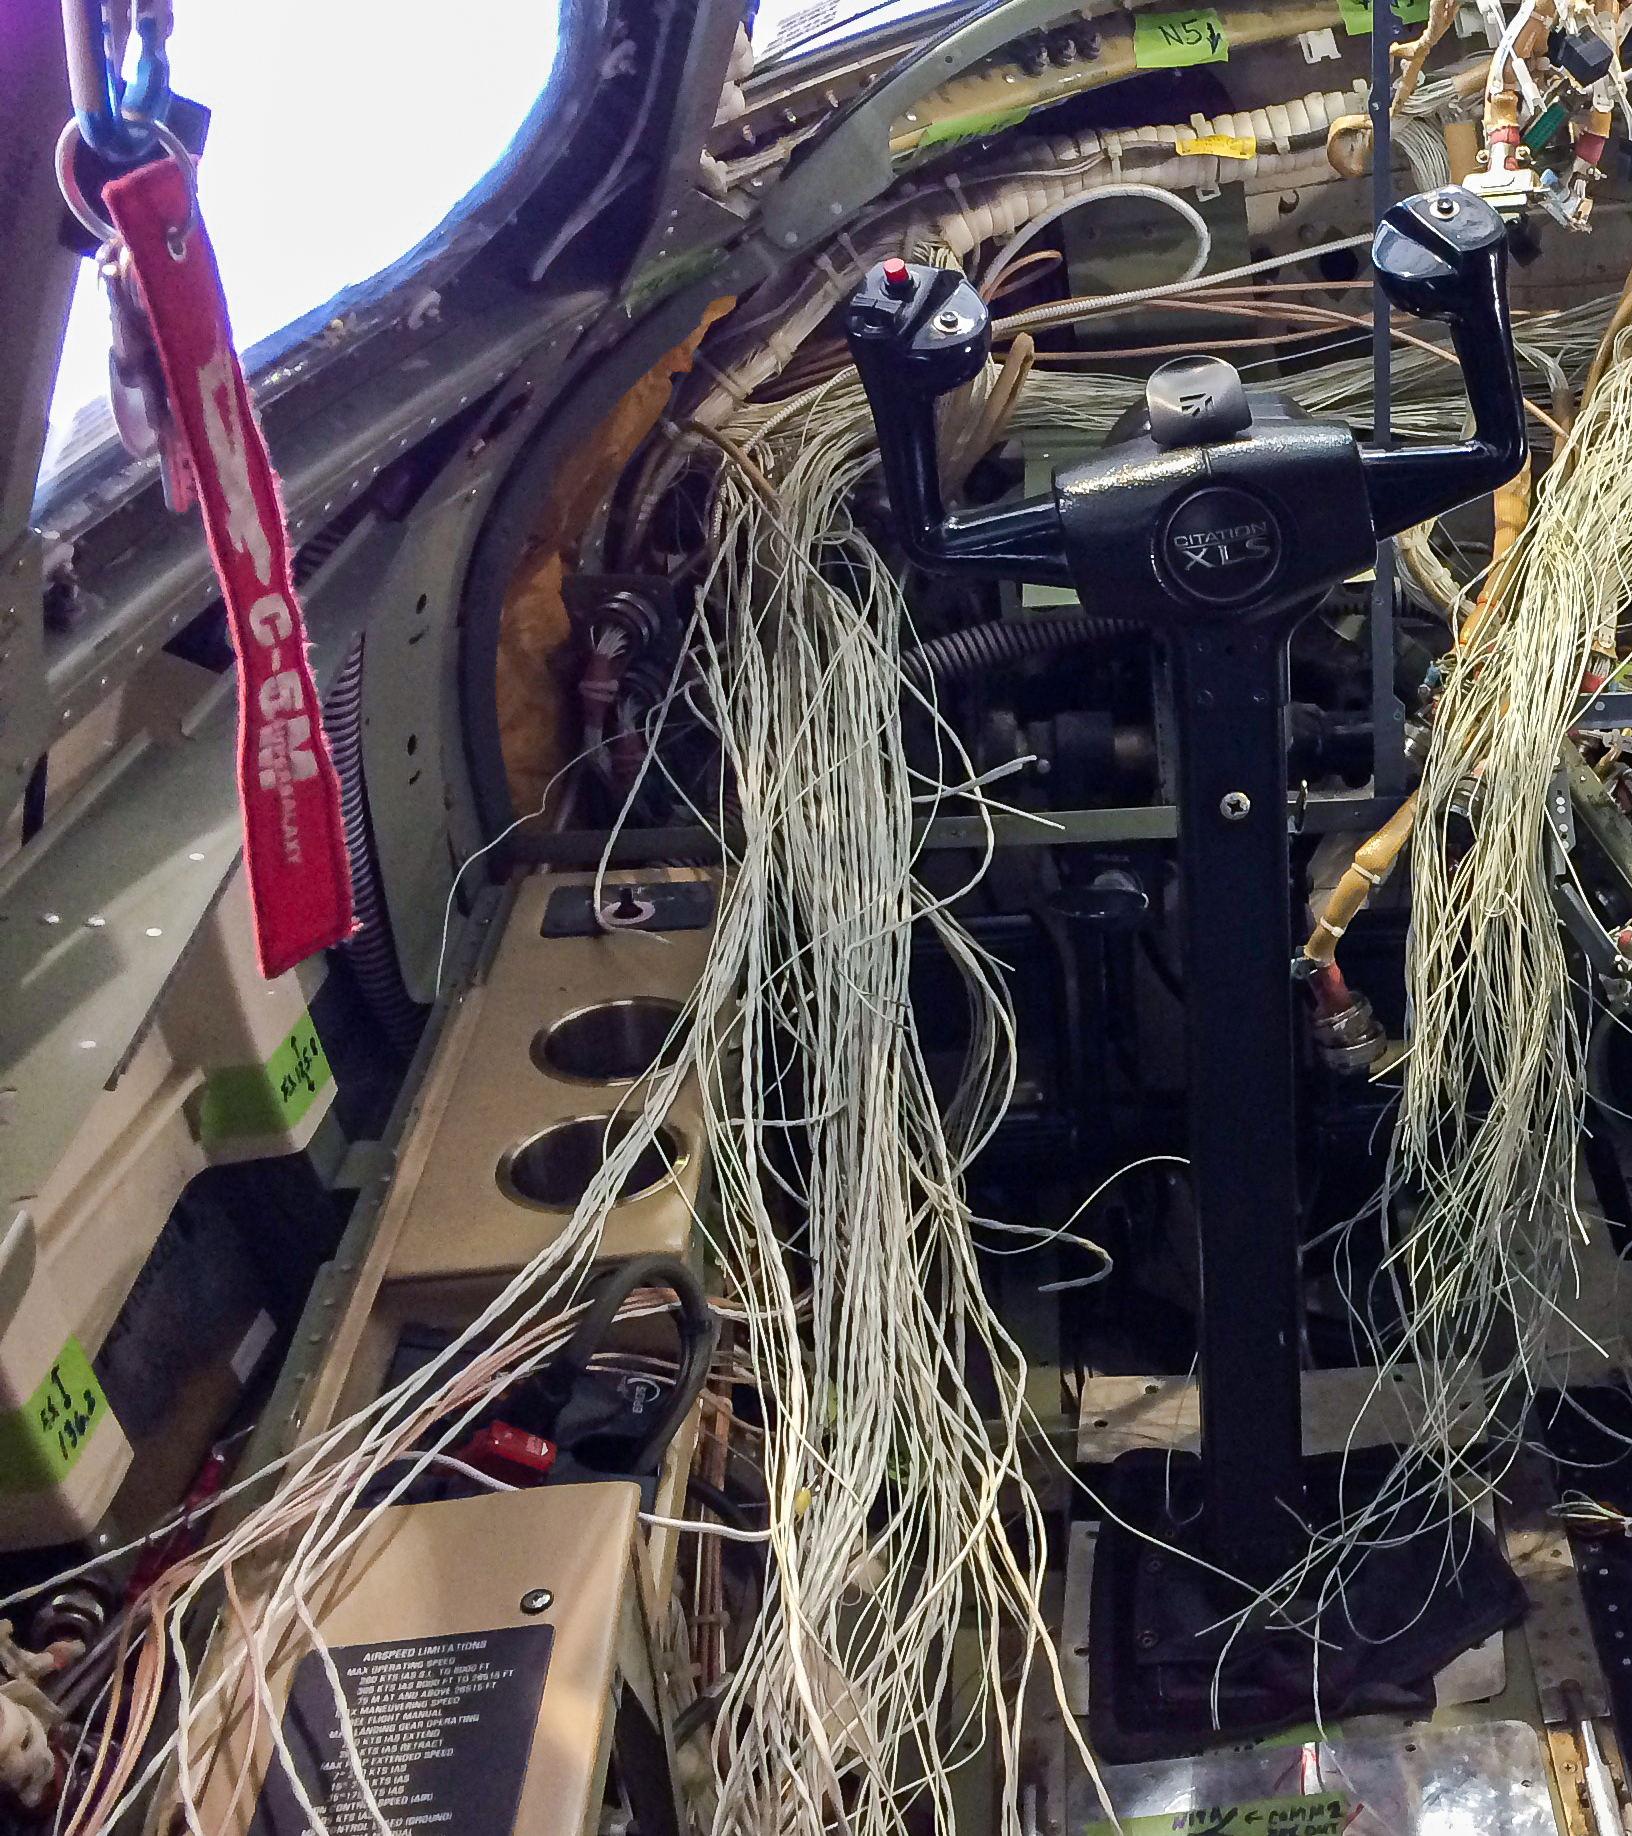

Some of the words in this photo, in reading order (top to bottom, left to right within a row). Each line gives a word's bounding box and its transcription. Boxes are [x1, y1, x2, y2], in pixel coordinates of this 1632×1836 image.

[1158, 18, 1202, 47] N5
[1173, 521, 1267, 547] CITATION
[1182, 537, 1271, 571] XLS
[363, 1648, 416, 1663] AIRSPEED
[417, 1640, 488, 1657] LIMITATIONS
[347, 1666, 368, 1676] MAX
[371, 1660, 425, 1674] OPERATING
[426, 1656, 457, 1668] SPEED
[379, 1673, 399, 1684] KTS
[478, 1662, 491, 1671] FT
[376, 1683, 397, 1694] KTS
[502, 1668, 515, 1679] FT
[382, 1693, 396, 1703] AT
[398, 1690, 419, 1701] AND
[420, 1687, 452, 1699] ABOVE
[359, 1701, 429, 1716] MANEUVERING
[430, 1696, 462, 1708] SPEED
[354, 1724, 397, 1738] LANDING
[398, 1720, 424, 1733] GEAR
[426, 1713, 481, 1729] OPERATING
[367, 1713, 402, 1726] FLIGHT
[402, 1709, 443, 1722] MANUAL
[402, 1729, 441, 1742] EXTEND
[400, 1739, 444, 1753] RETRACT
[370, 1752, 422, 1766] EXTENDED
[423, 1748, 455, 1760] SPEED
[390, 1763, 408, 1774] IAS
[393, 1773, 410, 1785] IAS
[387, 1785, 405, 1795] IAS
[377, 1795, 409, 1807] SPEED
